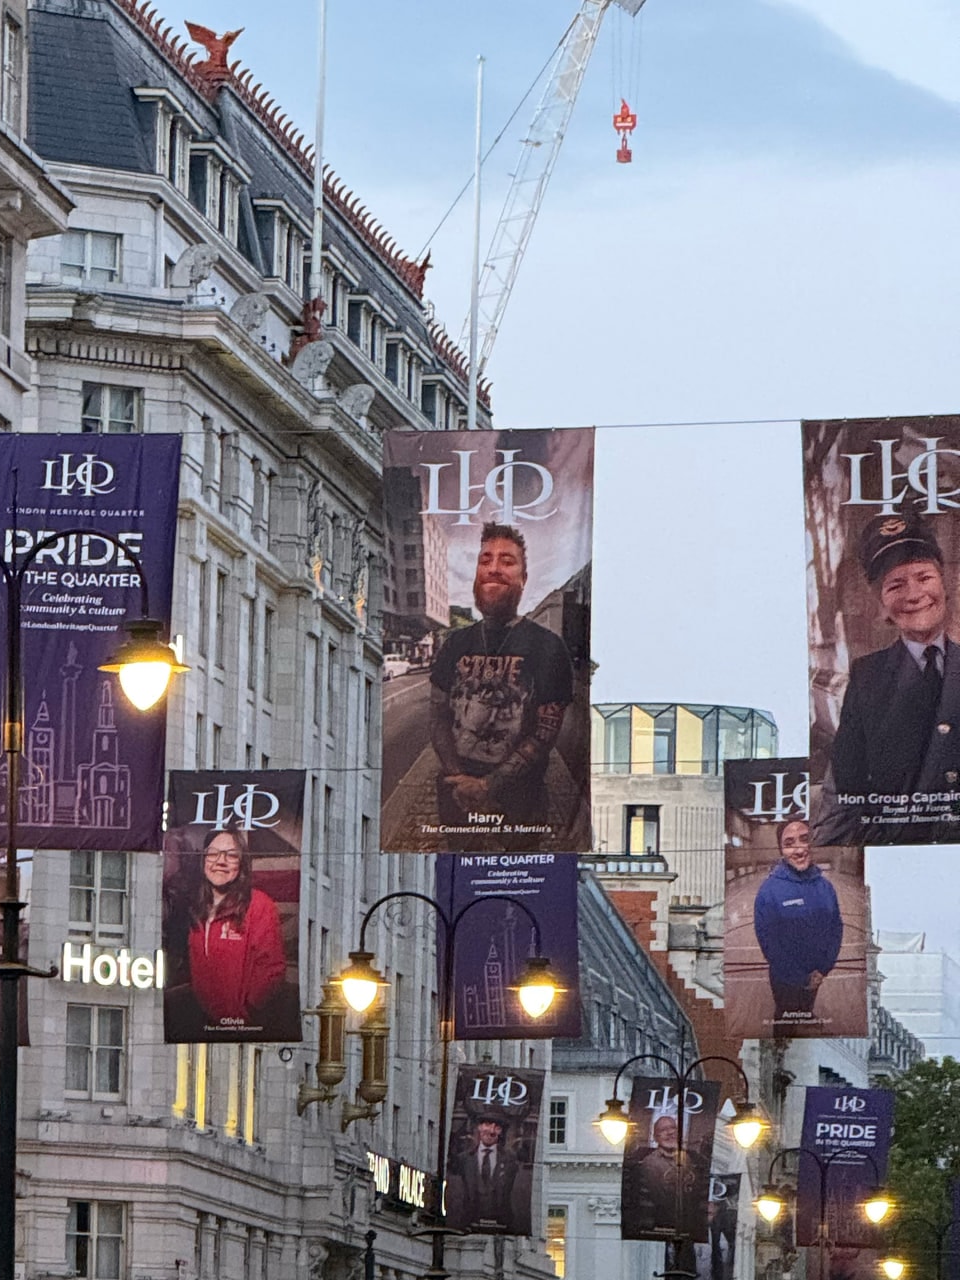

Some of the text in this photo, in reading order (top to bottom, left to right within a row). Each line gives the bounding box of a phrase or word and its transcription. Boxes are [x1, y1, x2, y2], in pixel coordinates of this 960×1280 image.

[50, 507, 97, 517] HERITAGE
[100, 509, 145, 517] QUARTER
[4, 529, 143, 567] PRIDE
[23, 571, 58, 585] THE
[61, 572, 141, 588] QUARTER
[42, 592, 103, 606] Celebrating
[78, 605, 86, 615] &
[88, 605, 126, 616] culture
[838, 794, 865, 805] Hon
[868, 793, 909, 806] Group
[909, 804, 923, 813] Air
[468, 812, 504, 825] Harry
[860, 815, 870, 824] St
[421, 824, 552, 833] The Connection at St Martin's
[460, 854, 555, 867] IN THE QUARTER
[487, 870, 529, 878] Celebrating
[62, 941, 164, 989] Hotel
[220, 1016, 245, 1025] Olivia
[782, 1010, 812, 1018] Amina
[816, 1122, 877, 1139] PRIDE
[399, 1164, 425, 1208] PALACE
